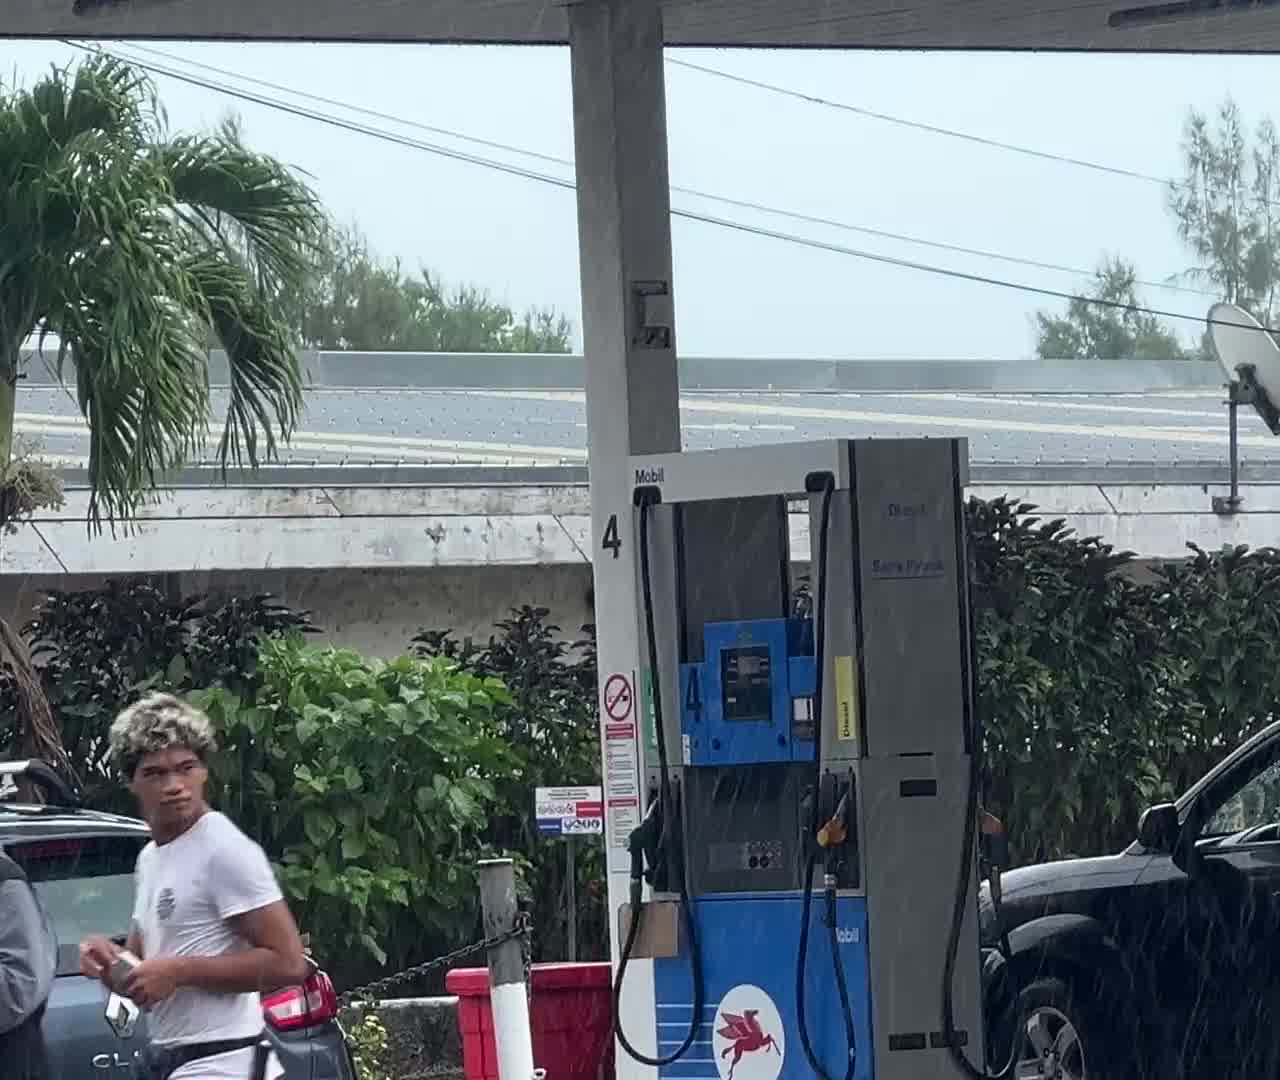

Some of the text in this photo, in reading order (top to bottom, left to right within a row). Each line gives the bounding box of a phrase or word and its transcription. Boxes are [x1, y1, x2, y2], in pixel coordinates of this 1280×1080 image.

[635, 466, 665, 484] Mobil
[602, 514, 622, 560] 4
[686, 667, 703, 723] 4
[835, 927, 860, 944] obil
